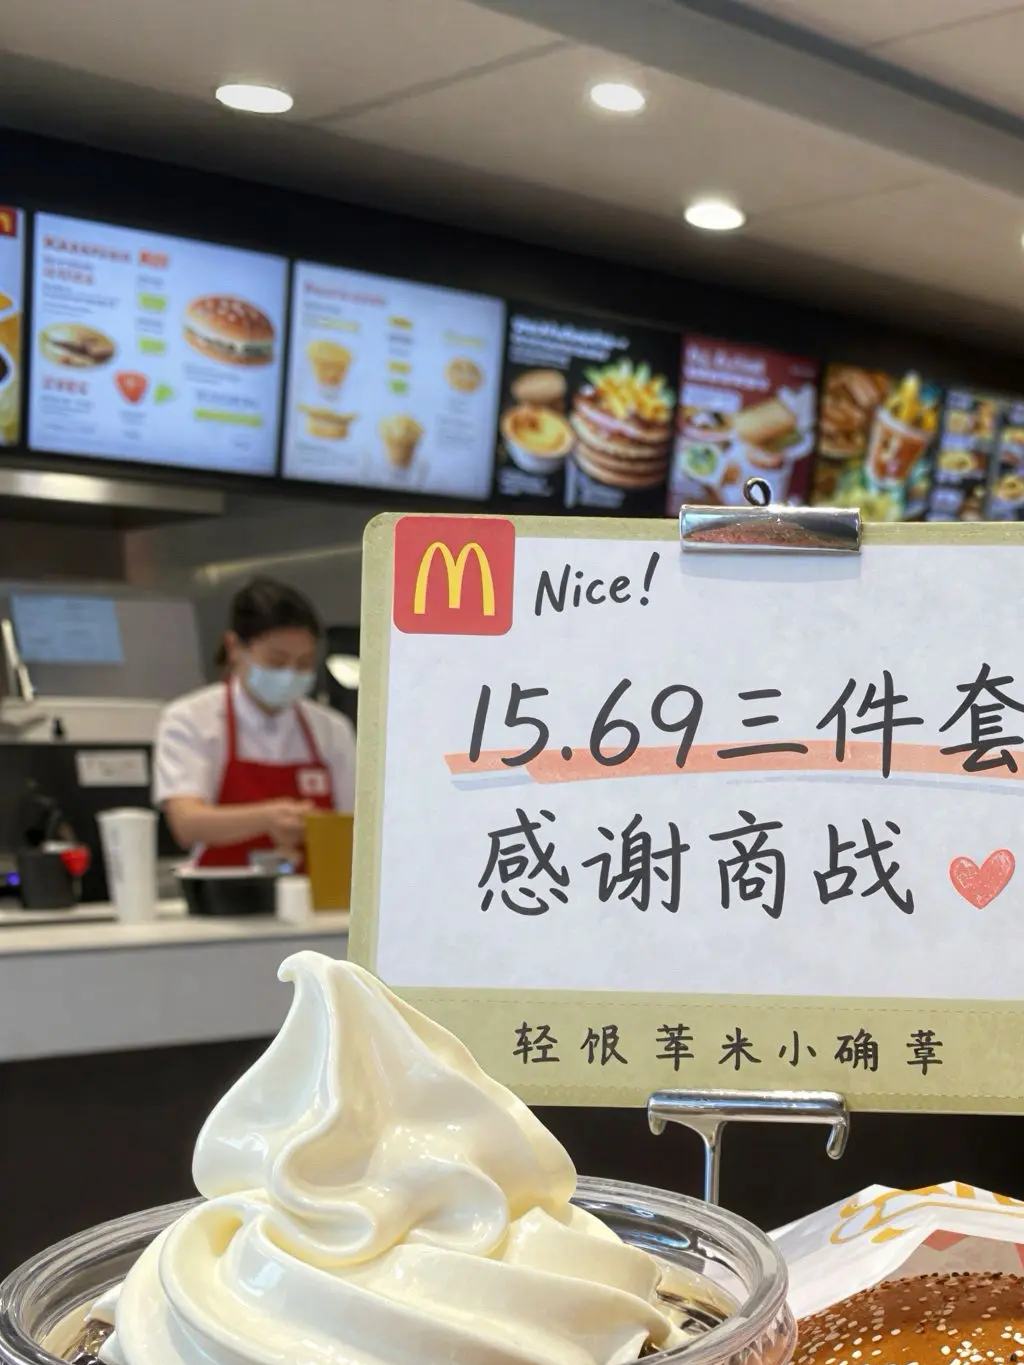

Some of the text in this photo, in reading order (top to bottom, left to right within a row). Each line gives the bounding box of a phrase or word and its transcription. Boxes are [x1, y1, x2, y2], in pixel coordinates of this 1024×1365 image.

[534, 551, 661, 617] Nice!
[477, 807, 915, 920] 感谢商战
